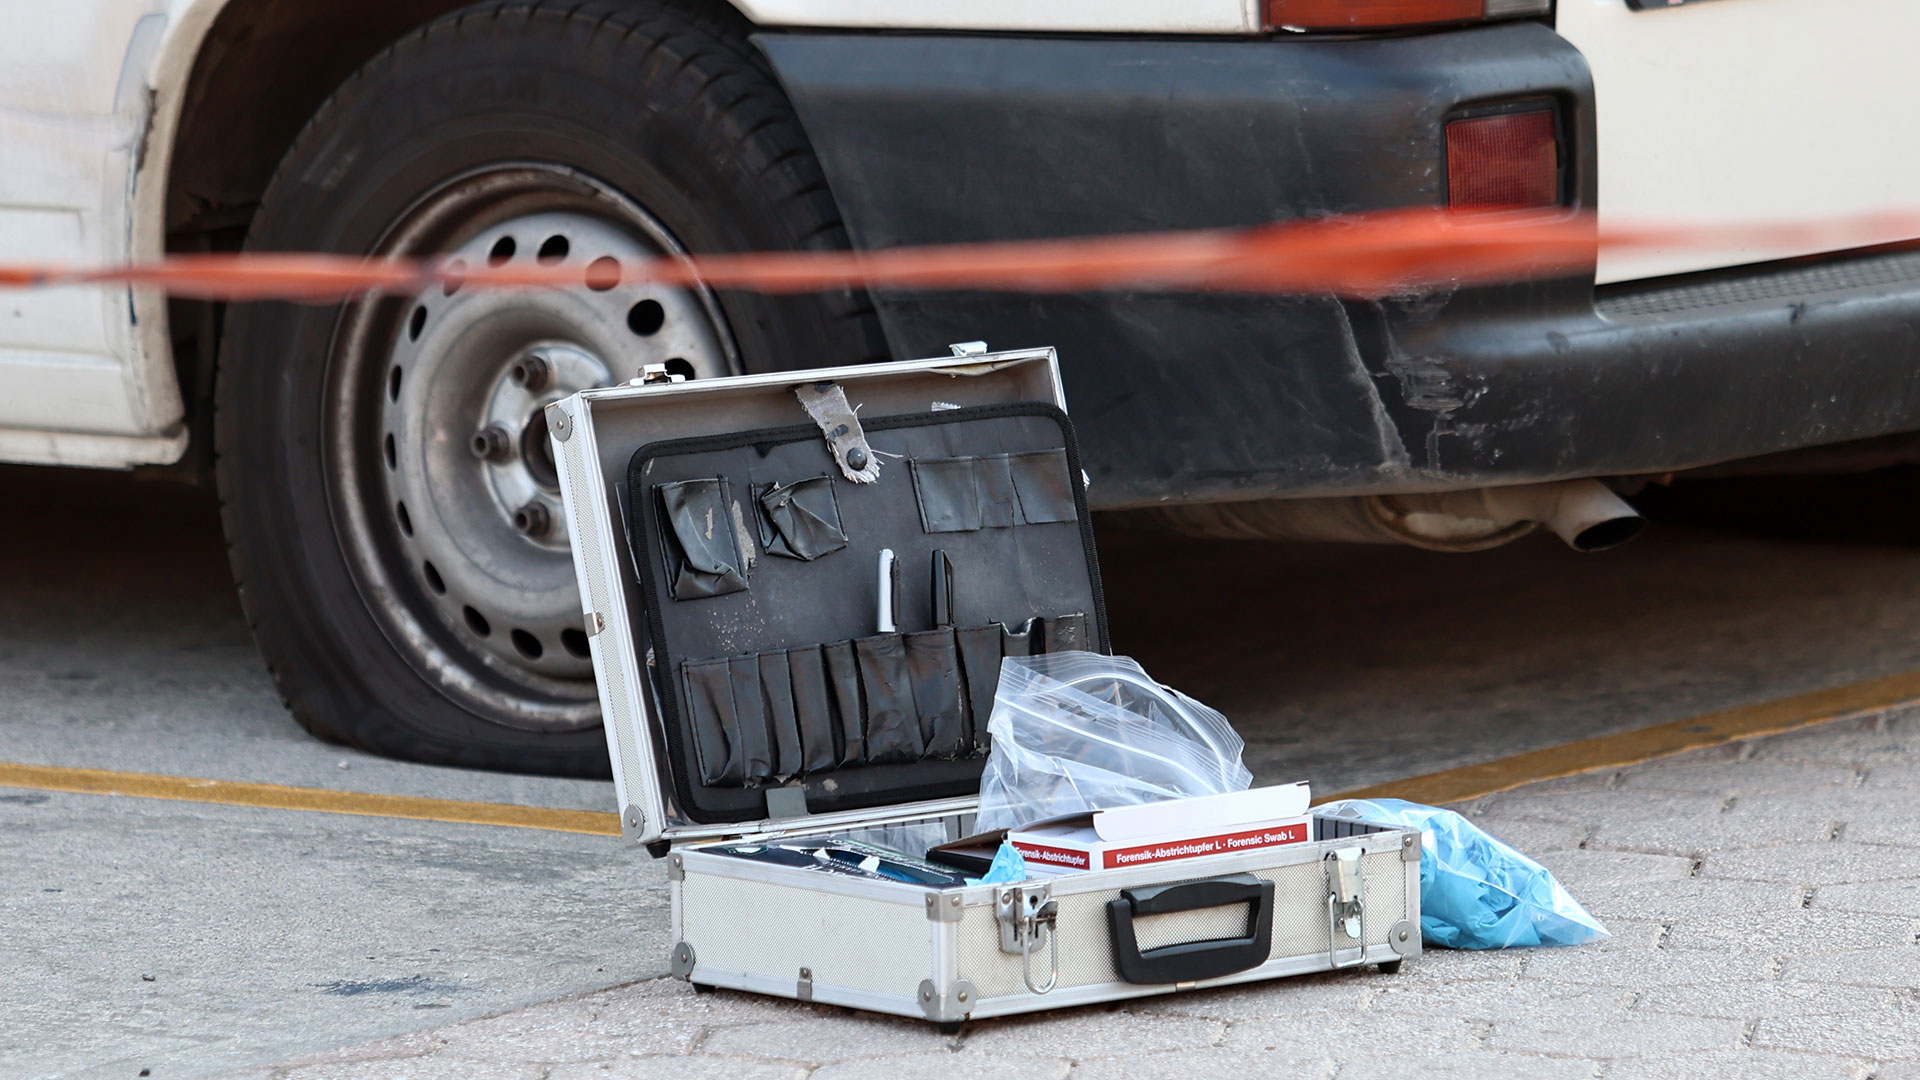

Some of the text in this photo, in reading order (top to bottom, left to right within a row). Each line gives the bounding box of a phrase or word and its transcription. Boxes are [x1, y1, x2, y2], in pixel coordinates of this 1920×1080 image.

[1116, 842, 1214, 863] Forensik-Abstrichtupfer
[1215, 841, 1221, 850] L
[1227, 834, 1262, 849] Forensic
[1264, 831, 1287, 843] Swab
[1288, 830, 1295, 840] L
